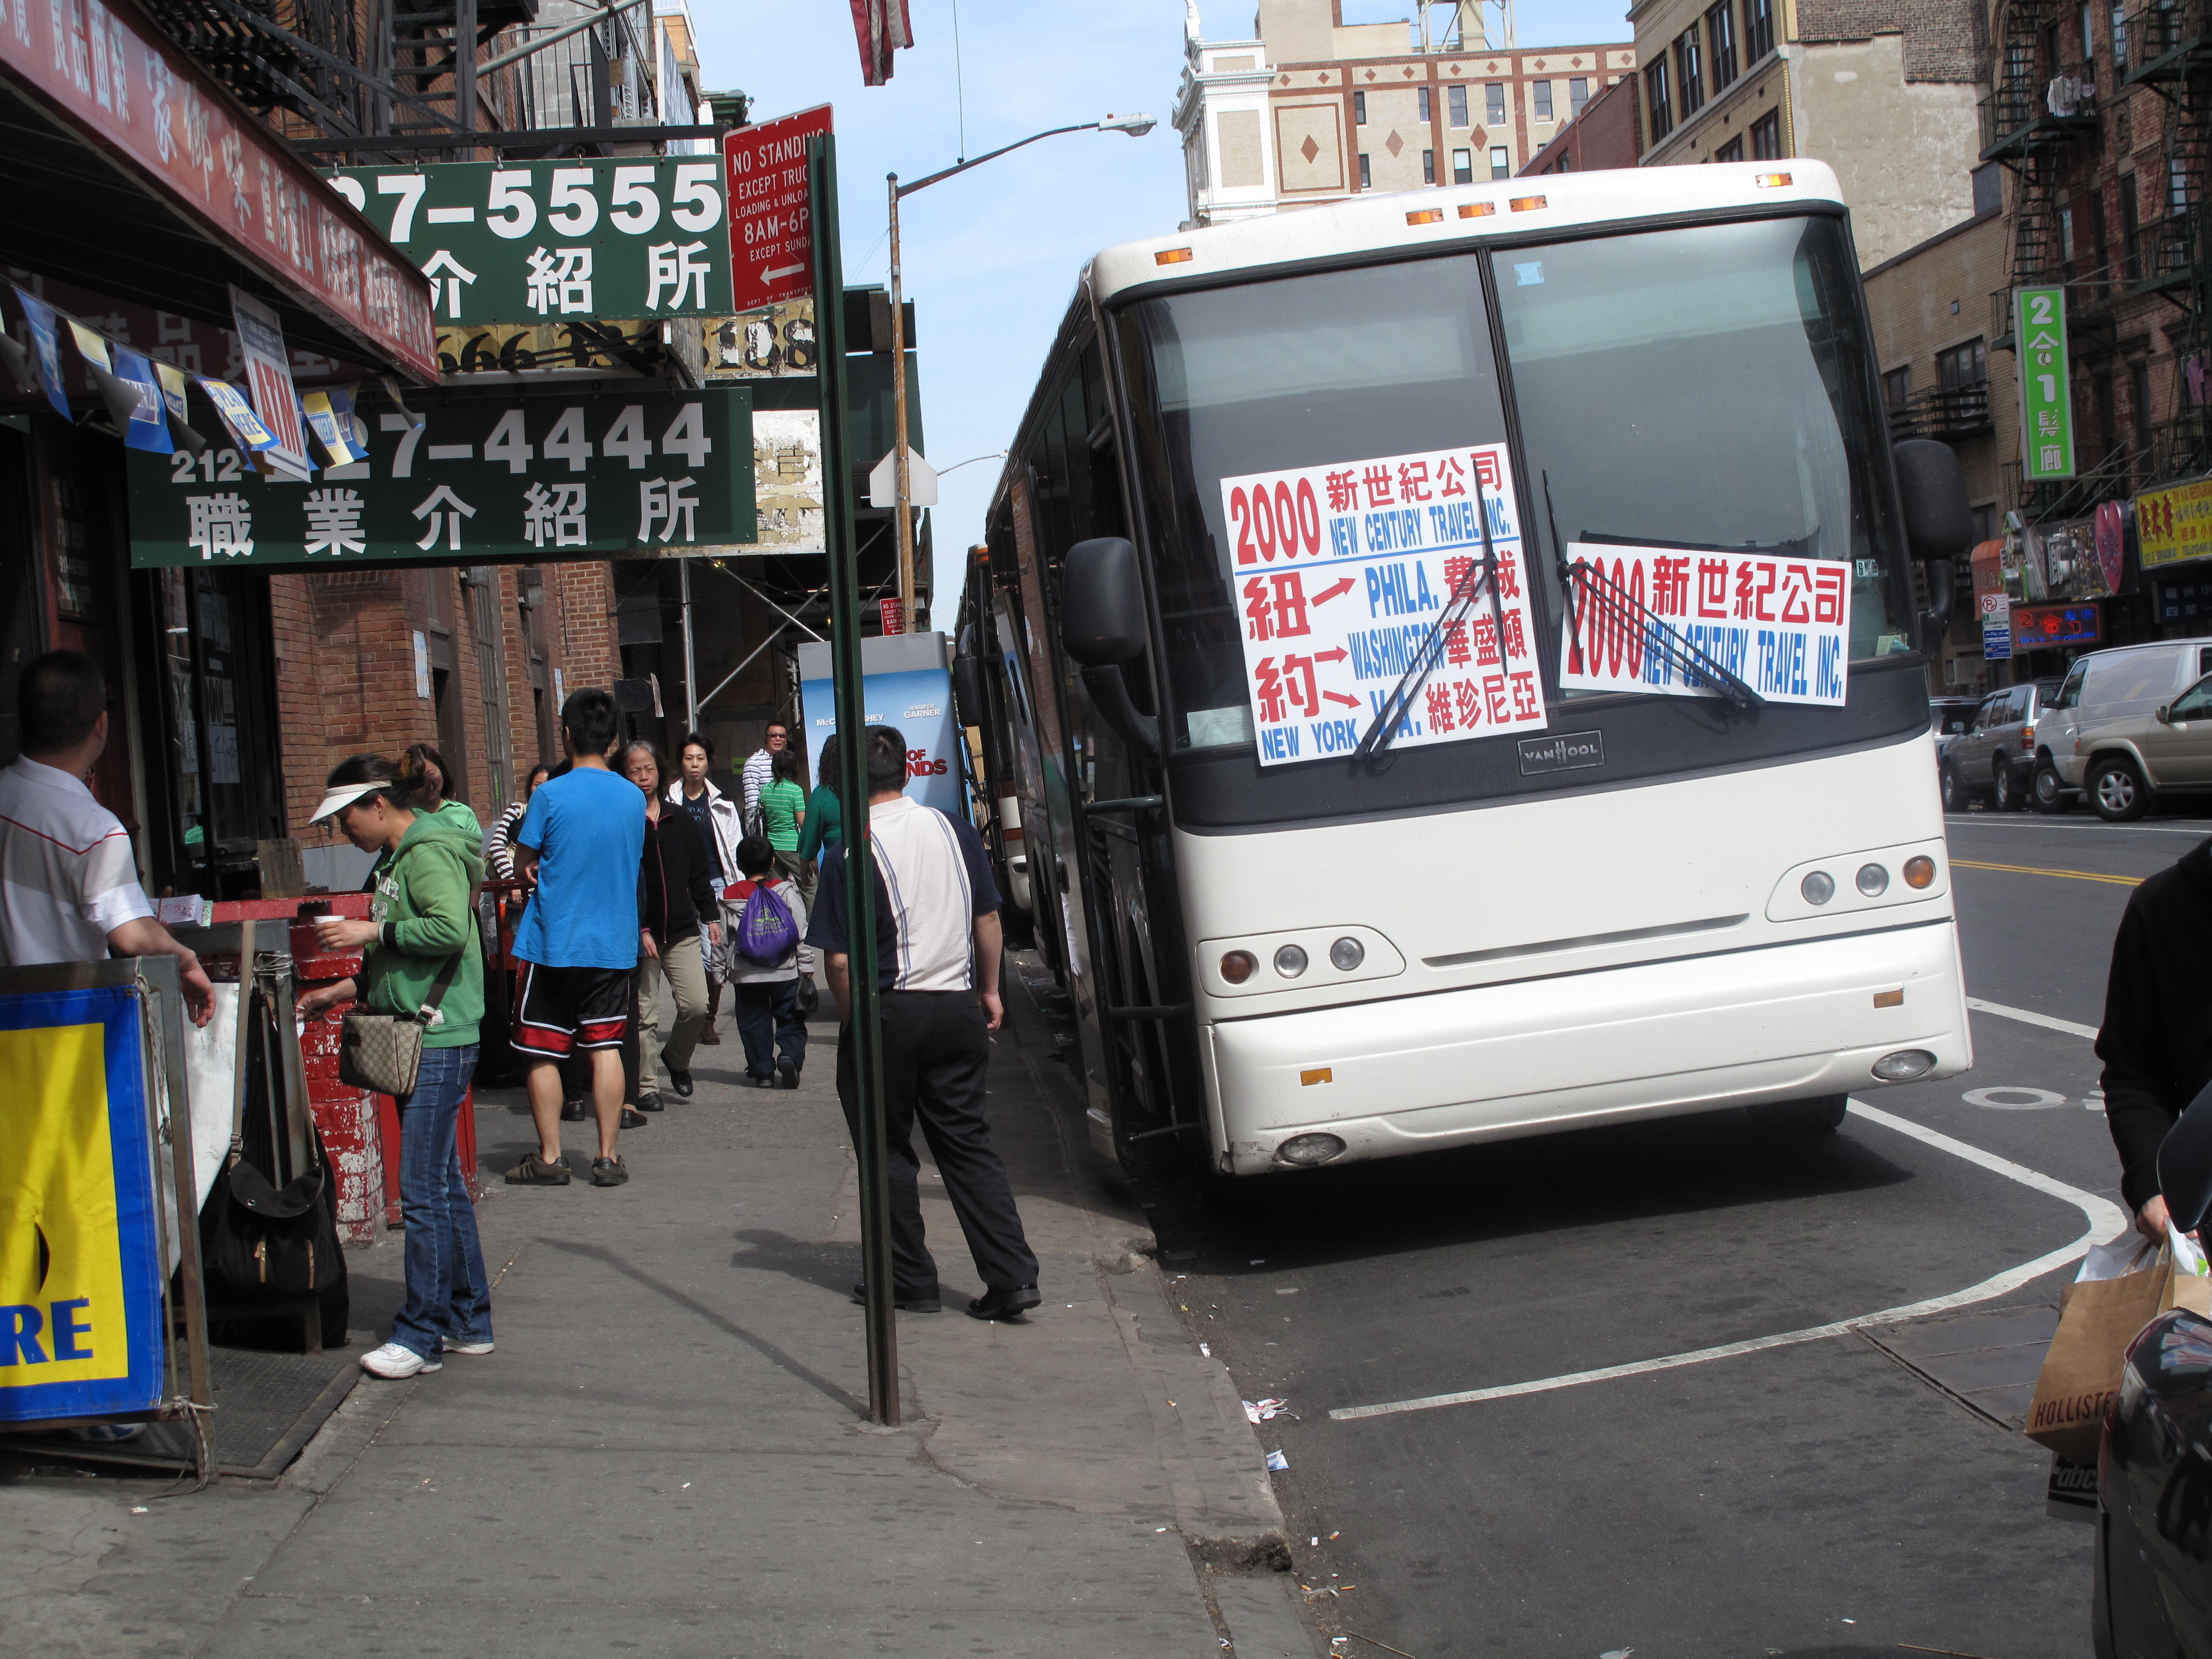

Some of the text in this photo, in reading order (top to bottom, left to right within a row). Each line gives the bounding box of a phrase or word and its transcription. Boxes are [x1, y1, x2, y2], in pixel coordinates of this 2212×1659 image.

[733, 128, 824, 175] NO STANDI
[735, 199, 770, 219] LOADING
[774, 198, 779, 207] &
[739, 174, 777, 200] EXCEPT
[421, 240, 711, 319] 介紹所
[750, 243, 781, 261] EXCEPT
[253, 357, 303, 458] ATM
[171, 450, 242, 483] 212
[1325, 450, 1502, 513] 新世紀公司
[185, 476, 700, 560] 職業介紹所
[1231, 477, 1320, 566] 2000
[1329, 496, 1510, 556] NEW CENTURY TRAVEL INC.
[1364, 560, 1439, 619] PHILA.
[1568, 557, 1645, 679] 2000
[1651, 555, 1845, 626] 新世紀公司
[1347, 622, 1445, 680] WASHINGTON
[1442, 608, 1527, 669] 華盛頓
[1642, 621, 1842, 699] NEW CENTURY TRAVEL INC.
[904, 709, 941, 719] GARNER
[1425, 671, 1540, 735] 維珍尼亞
[906, 749, 926, 761] OF
[1261, 725, 1299, 760] NEW
[1311, 718, 1360, 753] YORK
[0, 1298, 94, 1366] RE
